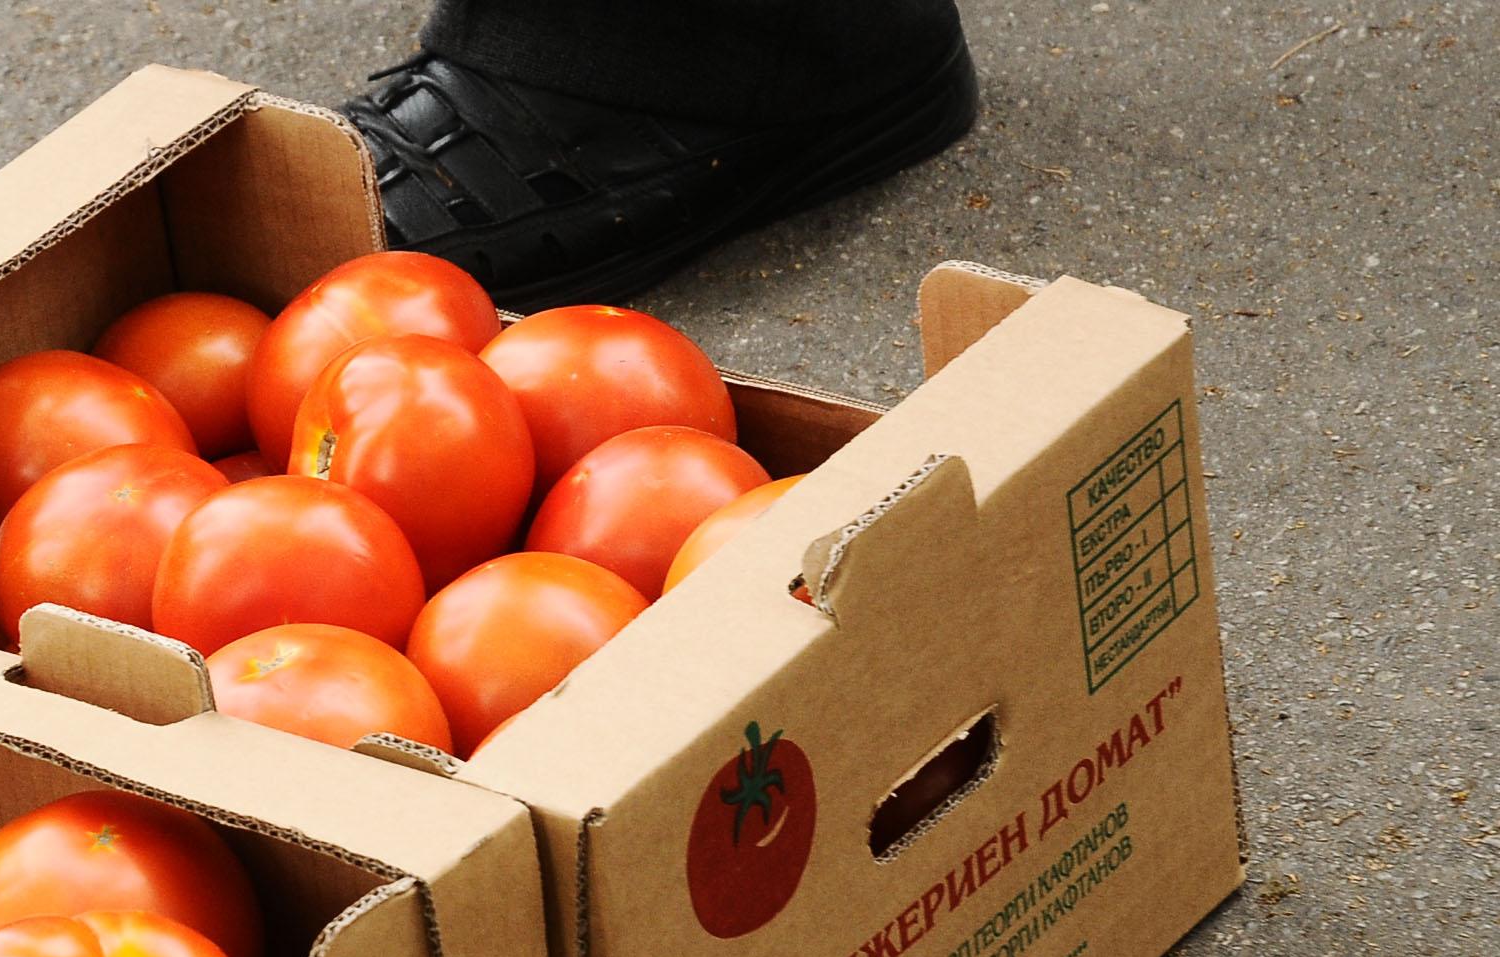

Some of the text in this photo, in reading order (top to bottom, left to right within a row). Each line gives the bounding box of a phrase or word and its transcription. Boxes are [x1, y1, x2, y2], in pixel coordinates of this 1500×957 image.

[1087, 427, 1165, 507] КАЧЕСТВО
[1080, 503, 1132, 557] ЕКСТРА
[1089, 585, 1134, 636] ВТОРО
[973, 881, 1038, 956] ГЕОРГИ
[1038, 802, 1129, 893] КАФТАНОВ
[1041, 835, 1133, 932] КАФТАНОВ
